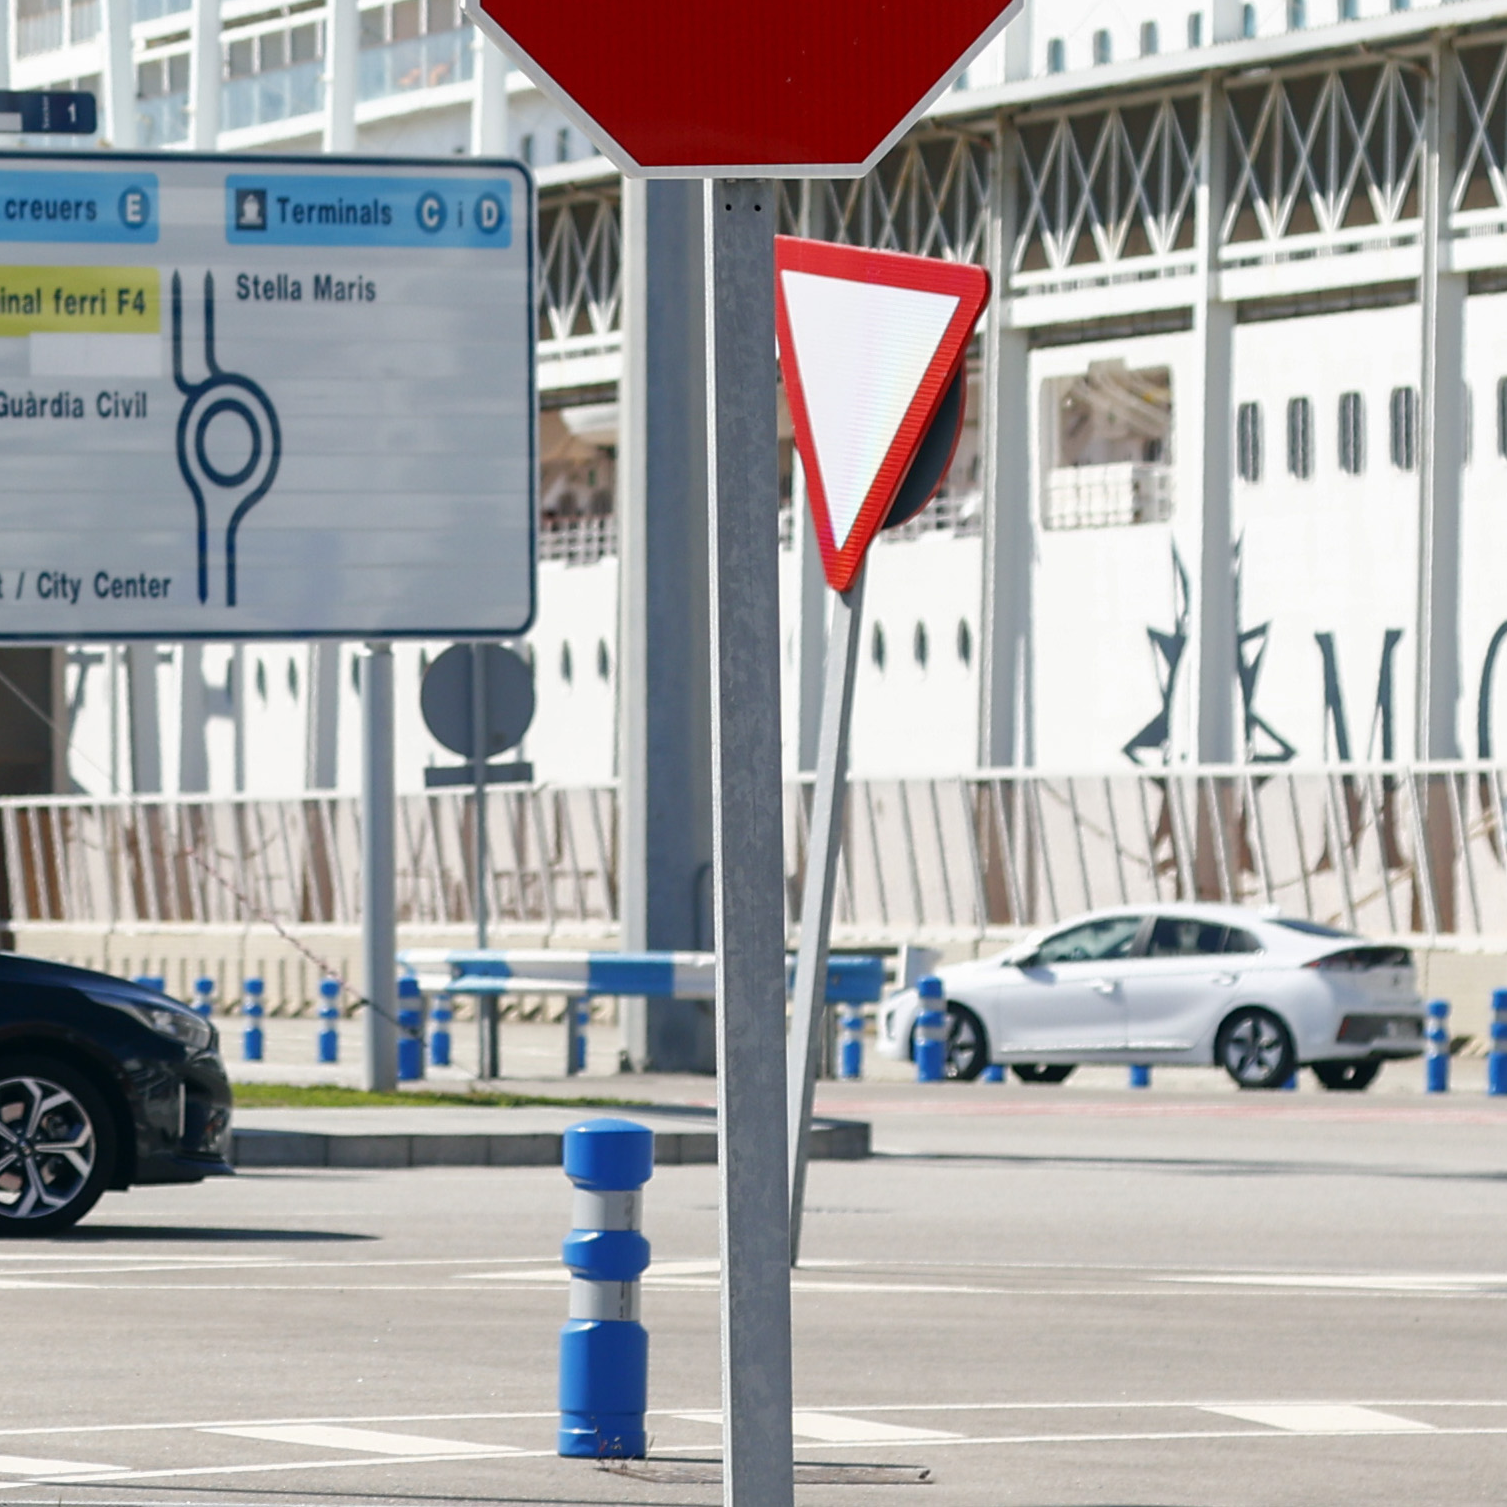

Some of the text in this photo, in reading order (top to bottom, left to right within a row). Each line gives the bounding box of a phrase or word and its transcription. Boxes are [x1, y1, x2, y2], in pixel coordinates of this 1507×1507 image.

[5, 199, 97, 221] creuers
[125, 193, 142, 223] E
[277, 197, 393, 225] Terminals
[421, 197, 442, 227] C
[480, 199, 498, 228] D
[54, 288, 107, 315] ferri
[117, 288, 146, 316] F4
[236, 273, 376, 302] Stella Maris
[96, 391, 147, 419] Civil
[37, 571, 81, 605] City
[93, 571, 172, 599] Center
